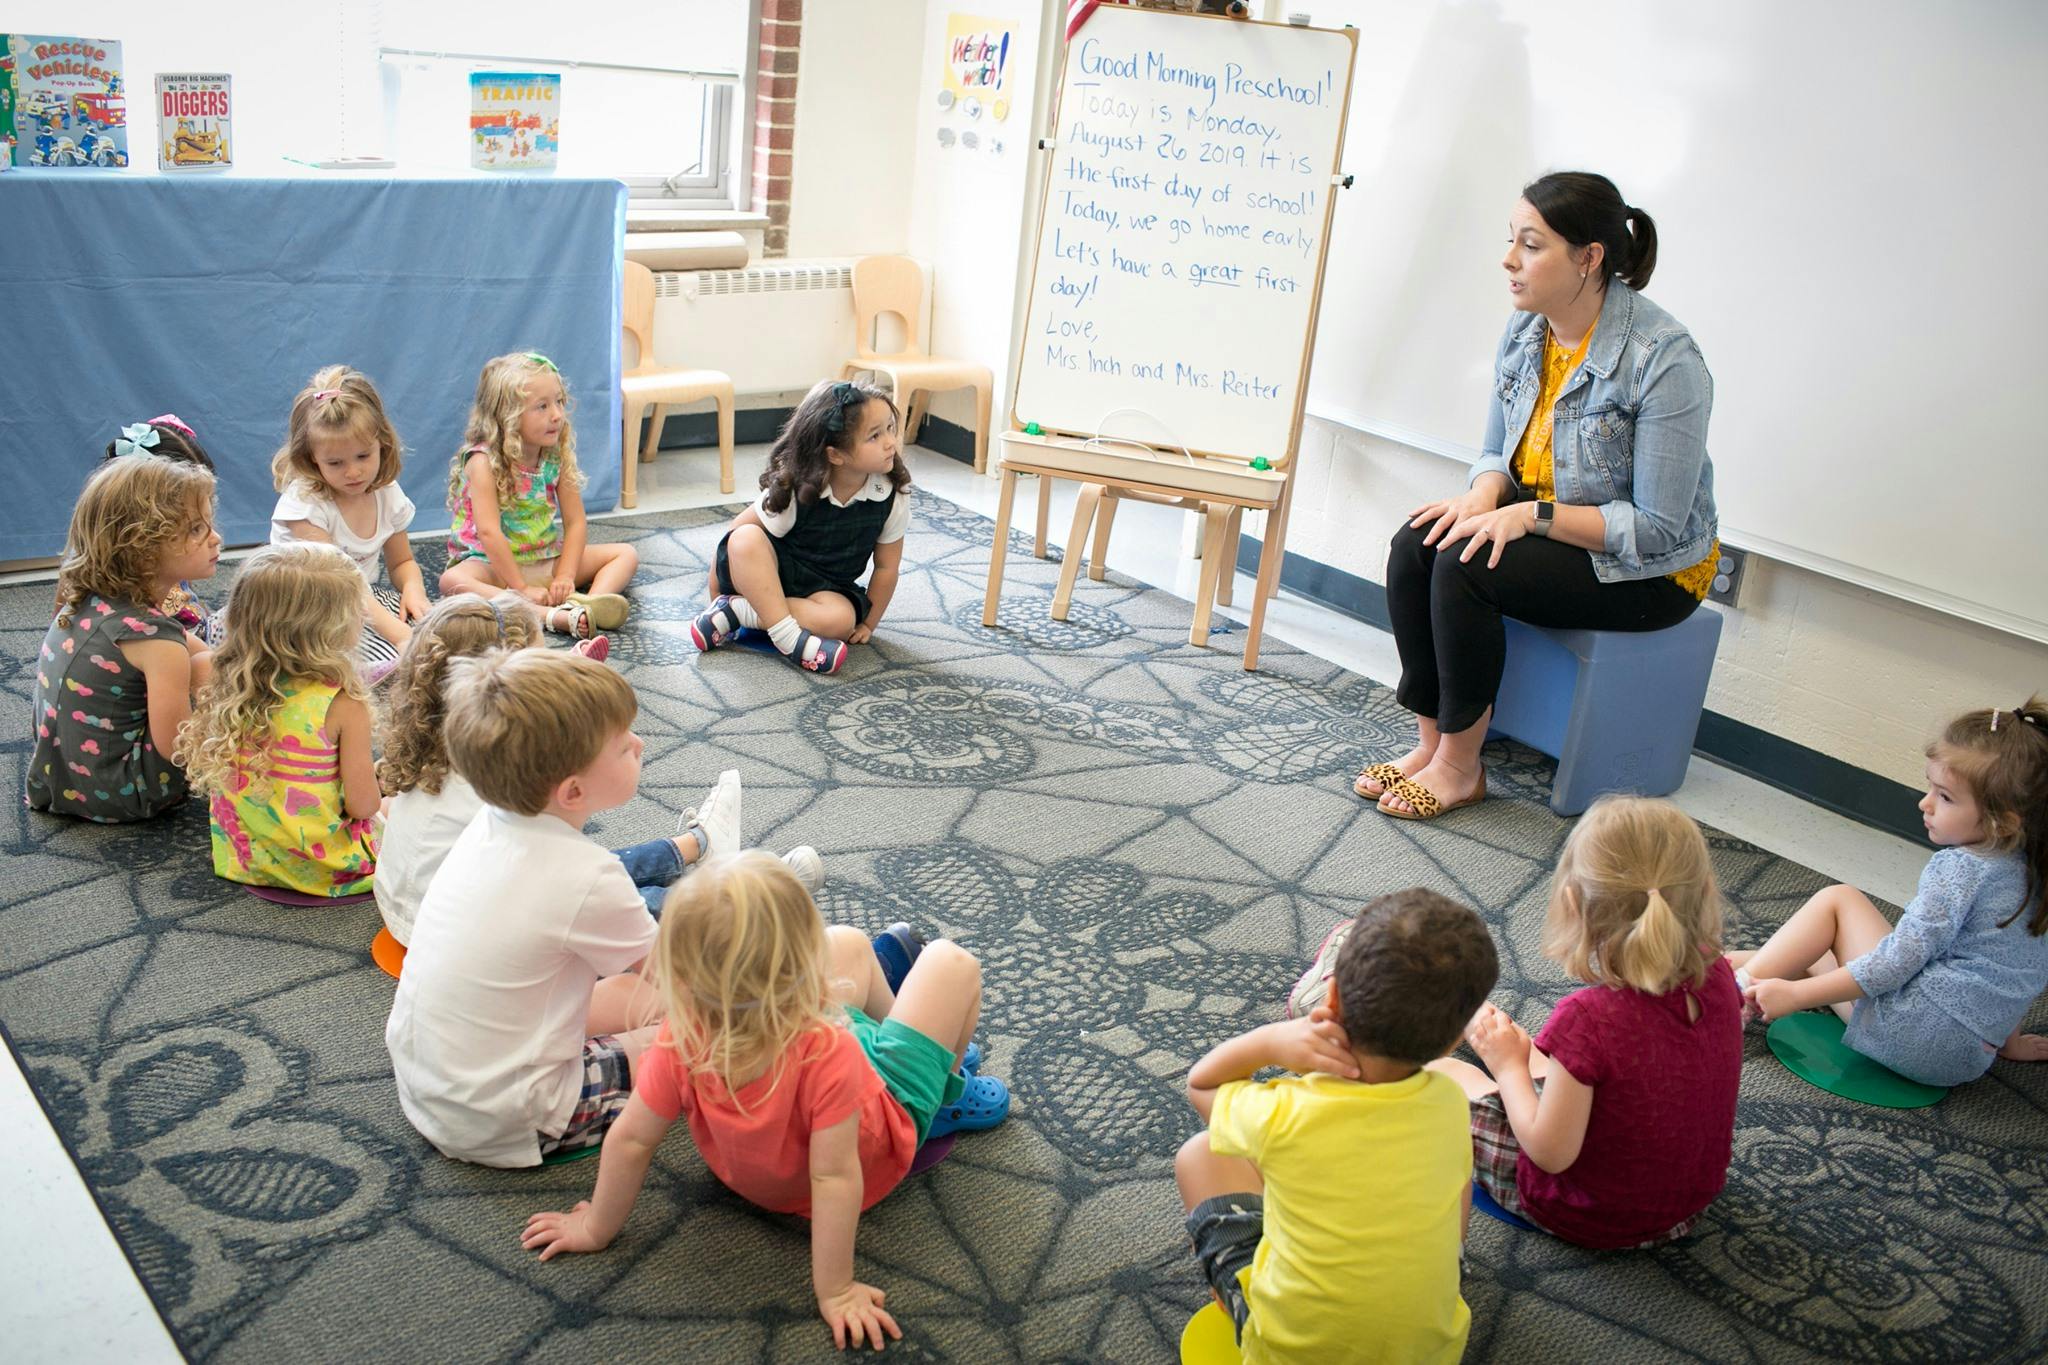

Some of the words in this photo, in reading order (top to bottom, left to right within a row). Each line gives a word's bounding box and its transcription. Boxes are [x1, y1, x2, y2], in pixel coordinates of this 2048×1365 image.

[27, 58, 111, 83] Vehicles
[34, 42, 106, 61] Rescue
[1080, 38, 1138, 80] Good
[1147, 51, 1217, 106] Morning
[1225, 62, 1332, 108] Preschool!
[163, 91, 228, 117] DIGGERS
[481, 86, 553, 101] TRAFFIC
[1074, 82, 1139, 128] Today
[1150, 98, 1172, 123] is
[1186, 106, 1281, 147] Monday,
[1070, 121, 1147, 158] August
[1156, 133, 1188, 161] 26
[1290, 152, 1313, 174] is
[1063, 156, 1101, 183] the
[1106, 166, 1156, 192] first
[1164, 172, 1202, 208] day
[1212, 183, 1232, 203] of
[1247, 190, 1316, 216] school!
[1058, 190, 1120, 232] Today,
[1129, 214, 1158, 231] we
[1169, 217, 1192, 244] go
[1202, 215, 1251, 239] home
[1054, 227, 1100, 267] Let's
[1112, 248, 1151, 278] have
[1161, 262, 1178, 279] a
[1190, 262, 1244, 287] great
[1255, 266, 1302, 293] first
[1050, 274, 1098, 308] day!
[1046, 311, 1099, 343] Love,
[1046, 344, 1081, 371] Mrs.
[1087, 350, 1121, 376] Inch
[1131, 361, 1164, 380] and
[1175, 361, 1214, 388] Mrs.
[1222, 369, 1282, 400] Reiter
